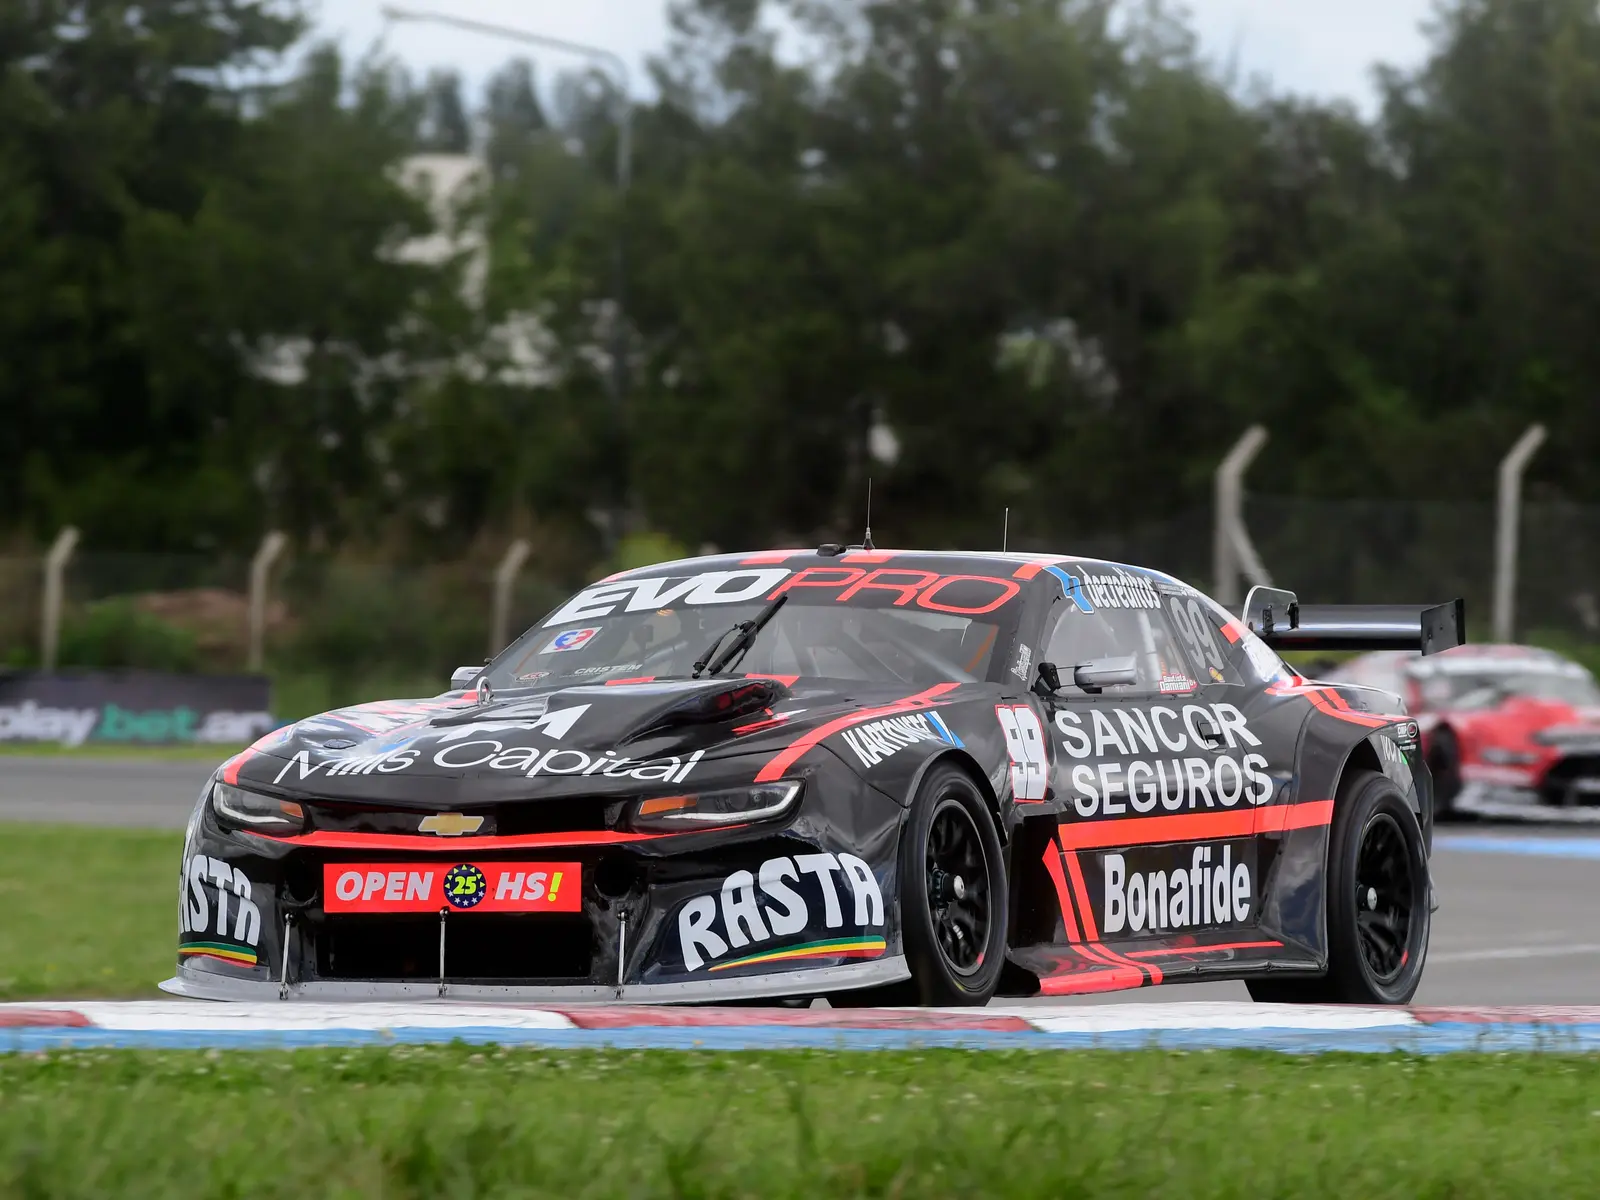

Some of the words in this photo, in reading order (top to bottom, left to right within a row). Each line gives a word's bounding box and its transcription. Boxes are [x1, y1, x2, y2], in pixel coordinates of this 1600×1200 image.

[1170, 597, 1224, 670] 99
[433, 740, 705, 783] Capital
[995, 704, 1048, 802] 99
[1055, 703, 1262, 758] SANCOR
[1072, 753, 1273, 817] SEGUROS
[178, 854, 261, 947] ASTA
[335, 871, 434, 901] OPEN
[453, 876, 477, 895] 25
[494, 872, 563, 902] HS!
[679, 852, 885, 972] RASTA
[1104, 845, 1251, 933] Bonafide
